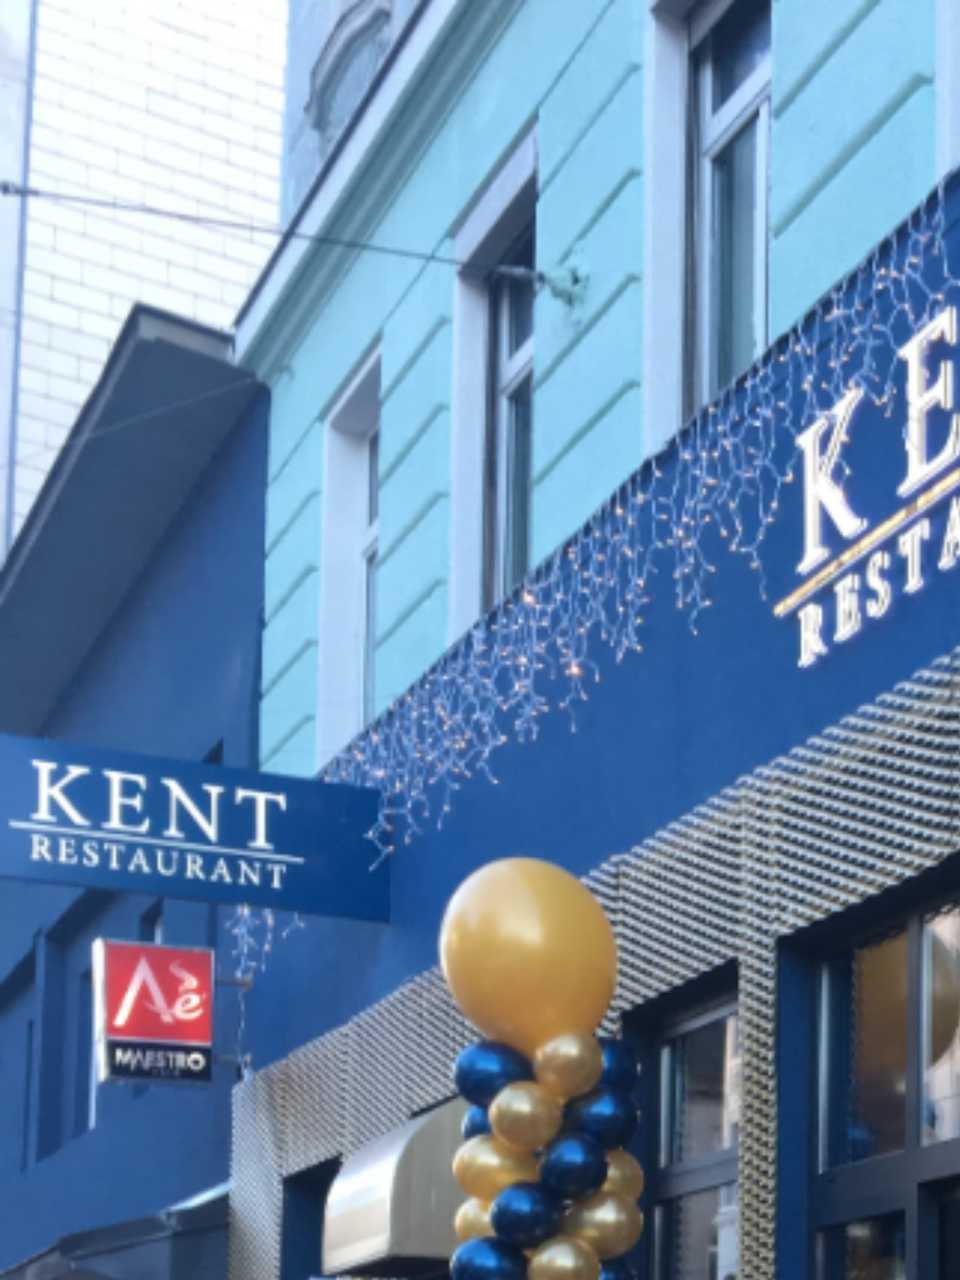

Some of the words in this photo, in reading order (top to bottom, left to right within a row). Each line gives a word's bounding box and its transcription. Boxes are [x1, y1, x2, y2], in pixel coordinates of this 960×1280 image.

[29, 758, 288, 852] KENT
[30, 832, 288, 890] RESTAURANT
[114, 1048, 207, 1072] MAESTRO
